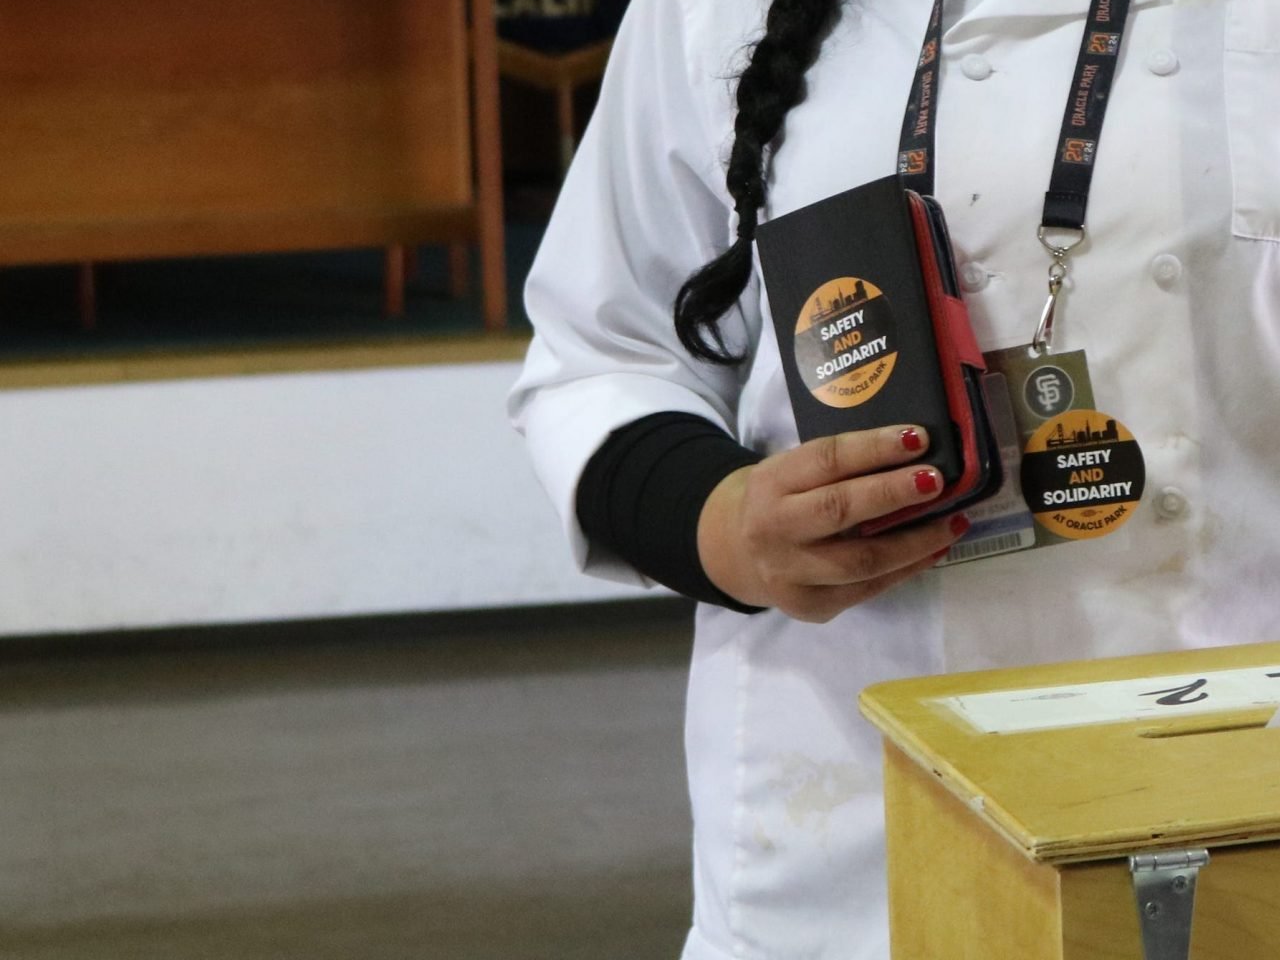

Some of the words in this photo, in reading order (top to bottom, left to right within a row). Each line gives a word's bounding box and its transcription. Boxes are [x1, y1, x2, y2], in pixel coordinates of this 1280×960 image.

[1080, 64, 1099, 87] PARK
[1072, 90, 1089, 126] ORACLE
[914, 109, 929, 136] PARK
[1084, 142, 1094, 153] 24
[821, 309, 864, 341] SAFETY
[833, 330, 862, 354] AND
[816, 335, 887, 380] SOLIDARITY
[838, 381, 870, 396] ORACLE
[868, 360, 887, 384] PARK
[1056, 449, 1111, 469] SAFETY
[1069, 468, 1104, 485] AND
[1043, 481, 1132, 505] SOLIDARITY
[1053, 513, 1066, 524] AT
[1065, 519, 1103, 531] ORACLE
[1103, 505, 1127, 526] PARK
